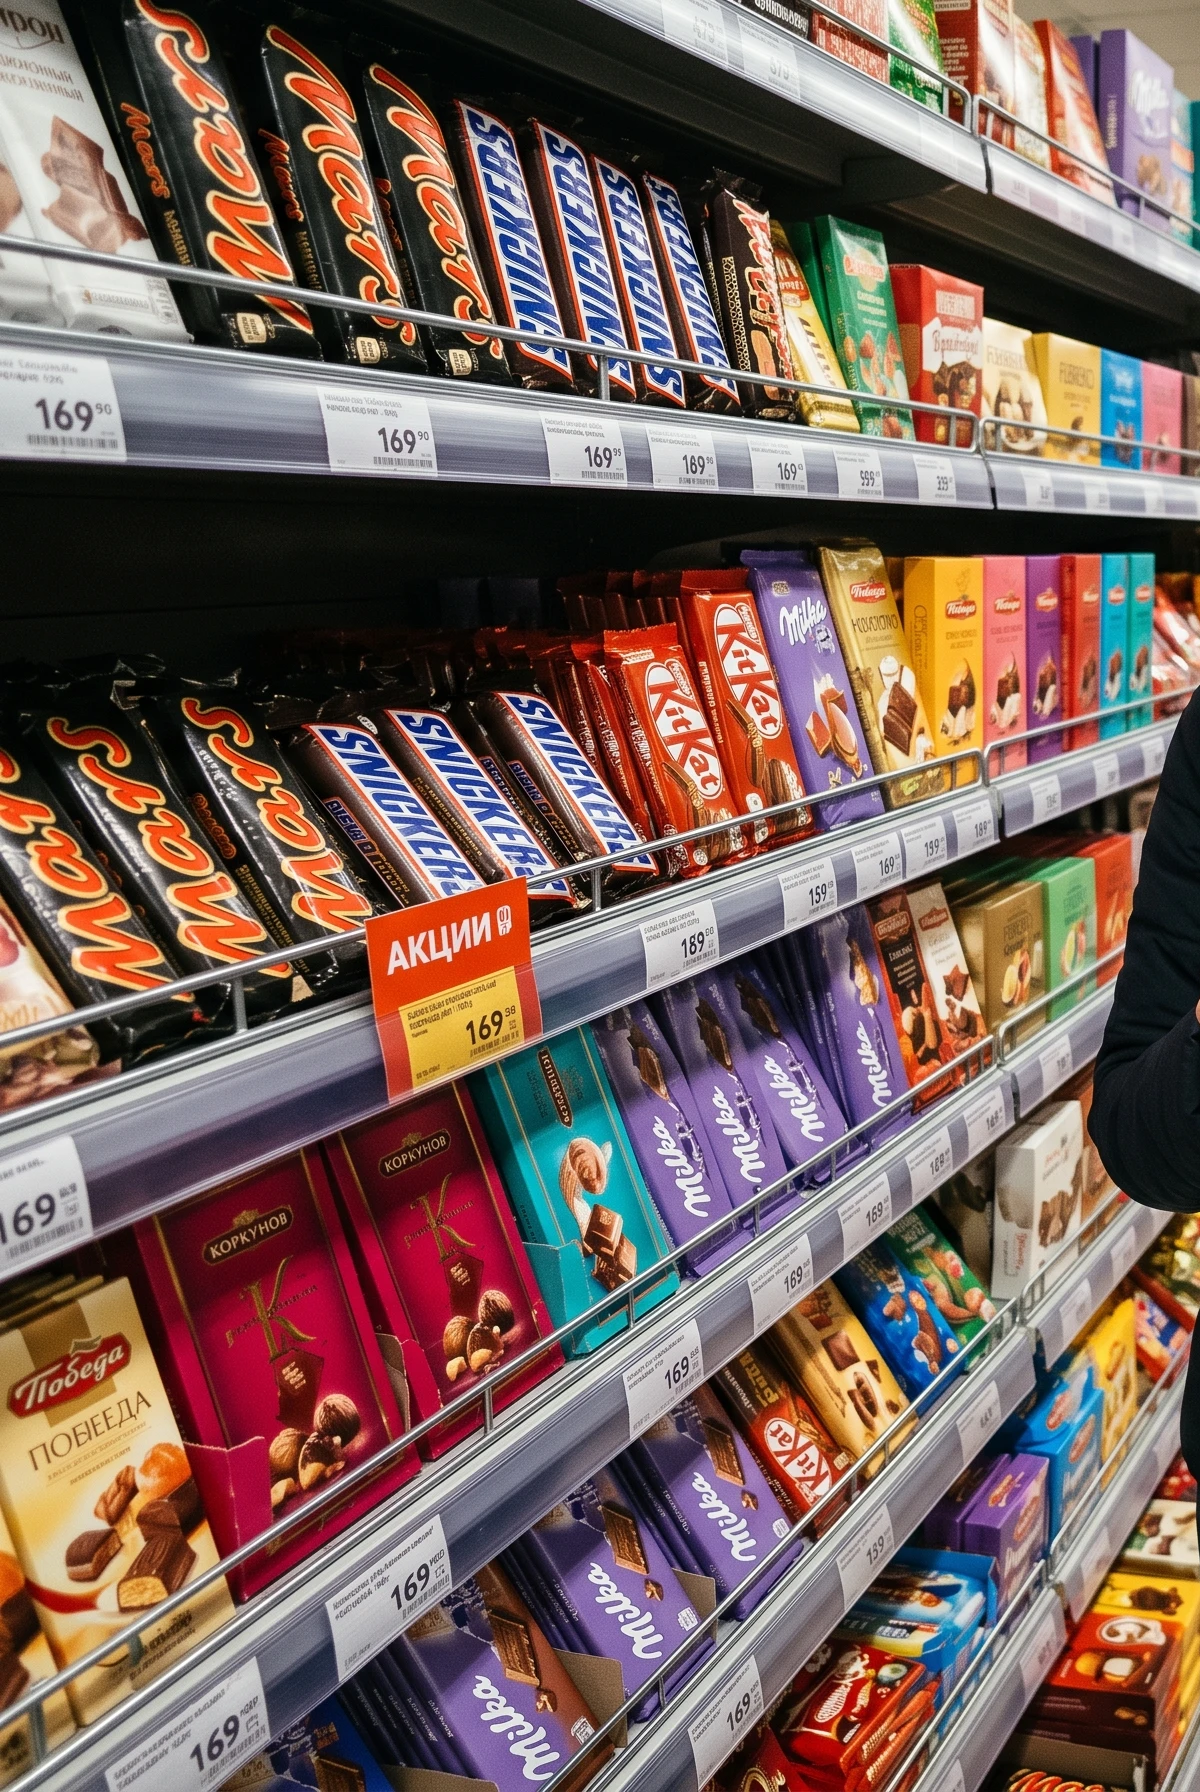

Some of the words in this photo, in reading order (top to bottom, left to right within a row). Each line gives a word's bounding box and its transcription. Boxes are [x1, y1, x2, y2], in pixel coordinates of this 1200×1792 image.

[135, 0, 313, 333] Mars
[266, 25, 416, 346] Mars
[369, 63, 504, 360] Mars
[35, 398, 94, 432] 169
[378, 427, 417, 454] 169
[584, 445, 613, 469] 169
[779, 596, 827, 646] Milka
[715, 622, 782, 731] KitKat
[648, 681, 720, 793] KitKat
[47, 717, 294, 979] Mars
[181, 698, 374, 946] Mars
[0, 748, 196, 1003] Mar
[387, 912, 492, 976] АКЦИИ
[466, 1010, 504, 1045] 169
[385, 1134, 447, 1173] КОРКУНОВ
[209, 1211, 289, 1259] КОРКУНОВ
[783, 1270, 804, 1295] 169
[15, 1345, 125, 1411] Победа
[663, 1355, 690, 1390] 169
[390, 1562, 431, 1611] 169
[726, 1692, 751, 1732] 169
[189, 1714, 240, 1772] 169
